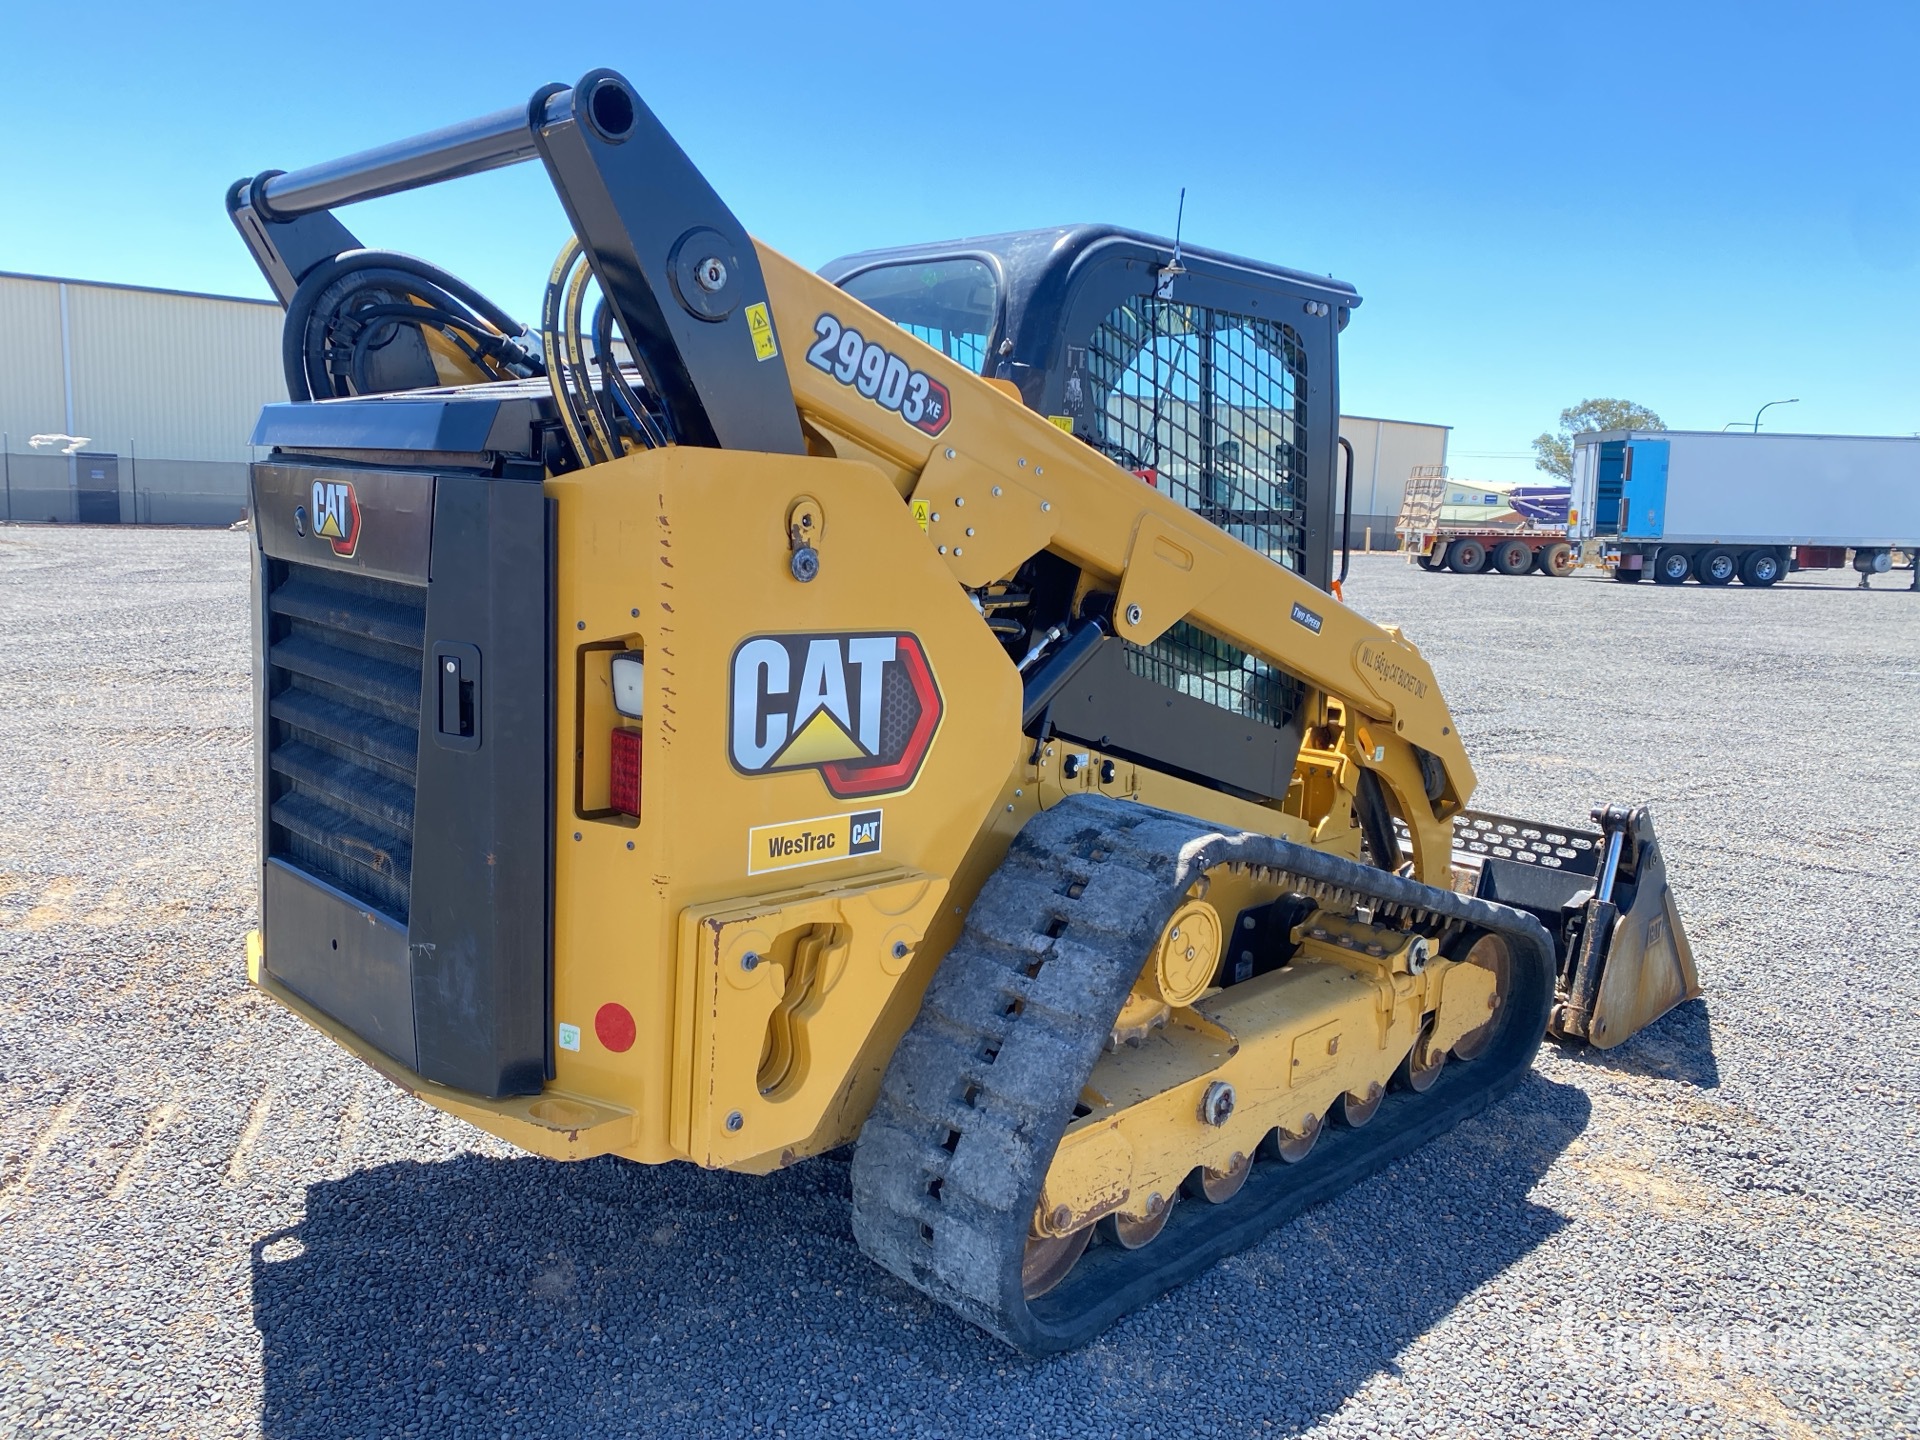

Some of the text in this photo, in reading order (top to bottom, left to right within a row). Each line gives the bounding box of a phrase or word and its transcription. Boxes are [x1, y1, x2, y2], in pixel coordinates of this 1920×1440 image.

[806, 314, 942, 424] 299D3 XE
[312, 481, 348, 538] CAT
[733, 636, 897, 770] CAT
[768, 820, 878, 858] WesTrac CAT
